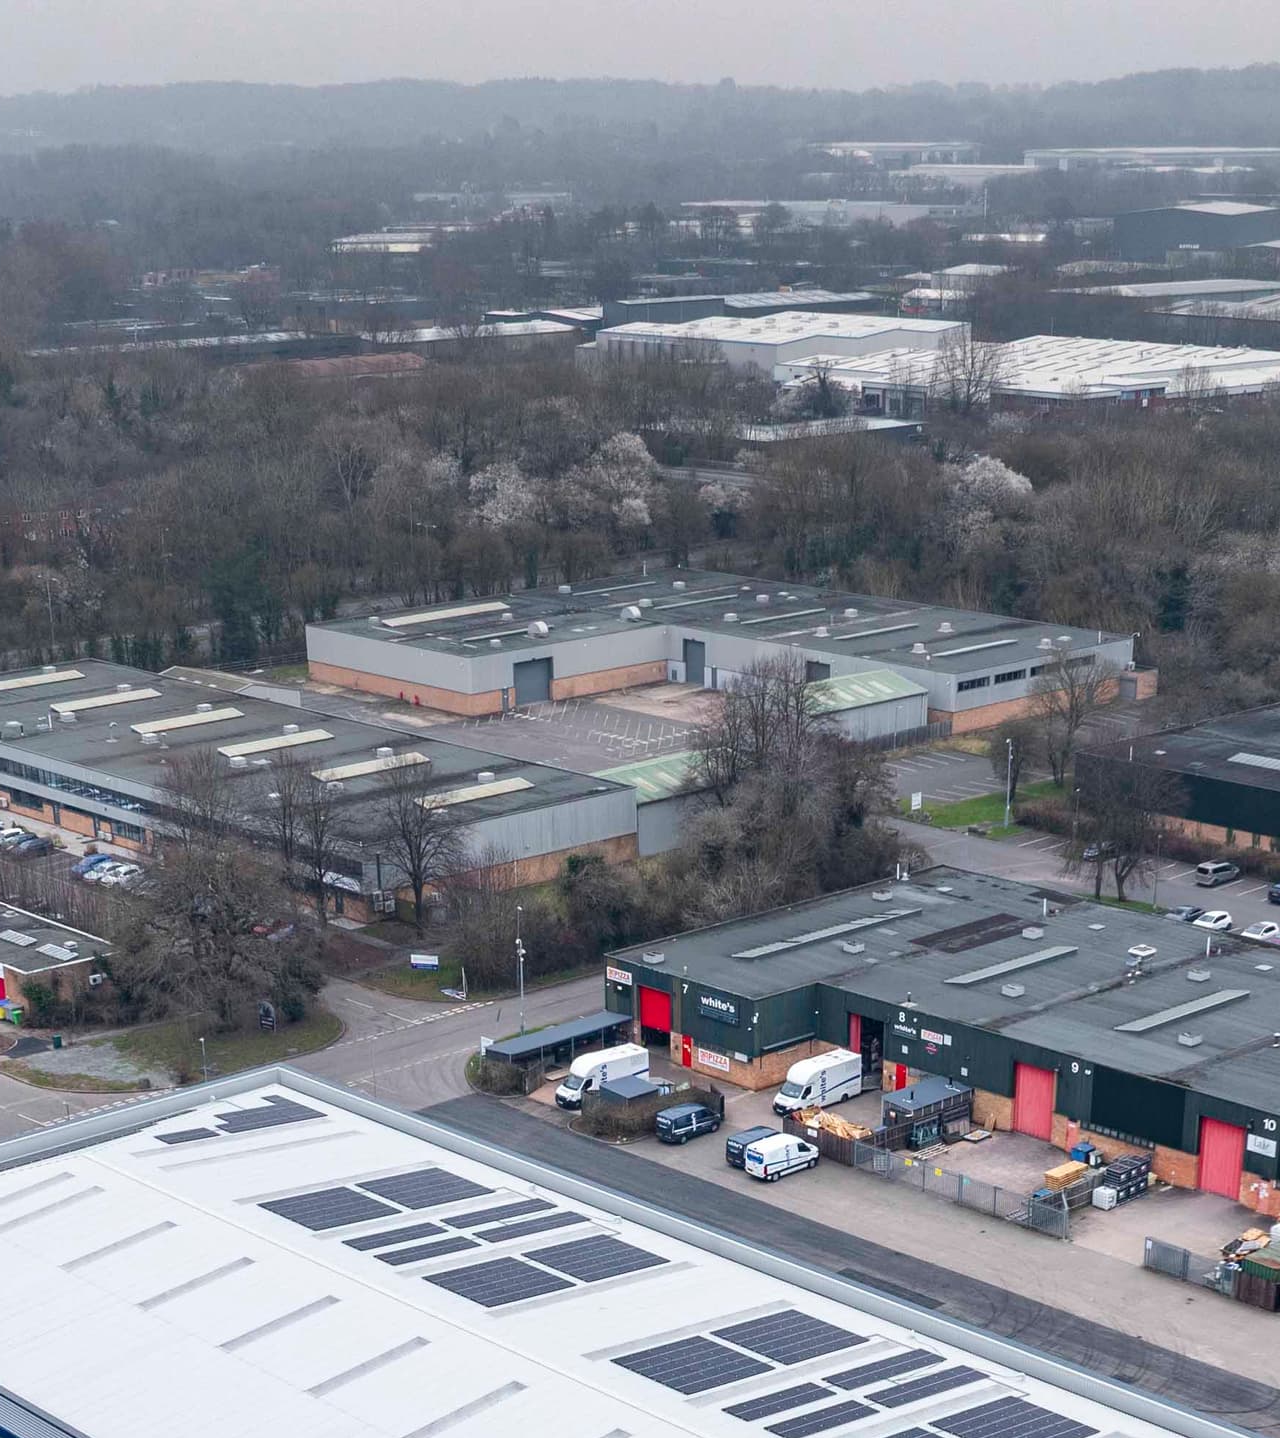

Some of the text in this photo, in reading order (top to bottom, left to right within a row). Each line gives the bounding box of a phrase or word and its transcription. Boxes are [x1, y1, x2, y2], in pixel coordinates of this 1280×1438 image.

[682, 983, 689, 994] 7
[700, 996, 736, 1013] white's
[898, 1011, 906, 1022] 8
[1071, 1061, 1079, 1073] 9
[1263, 1118, 1277, 1131] 10
